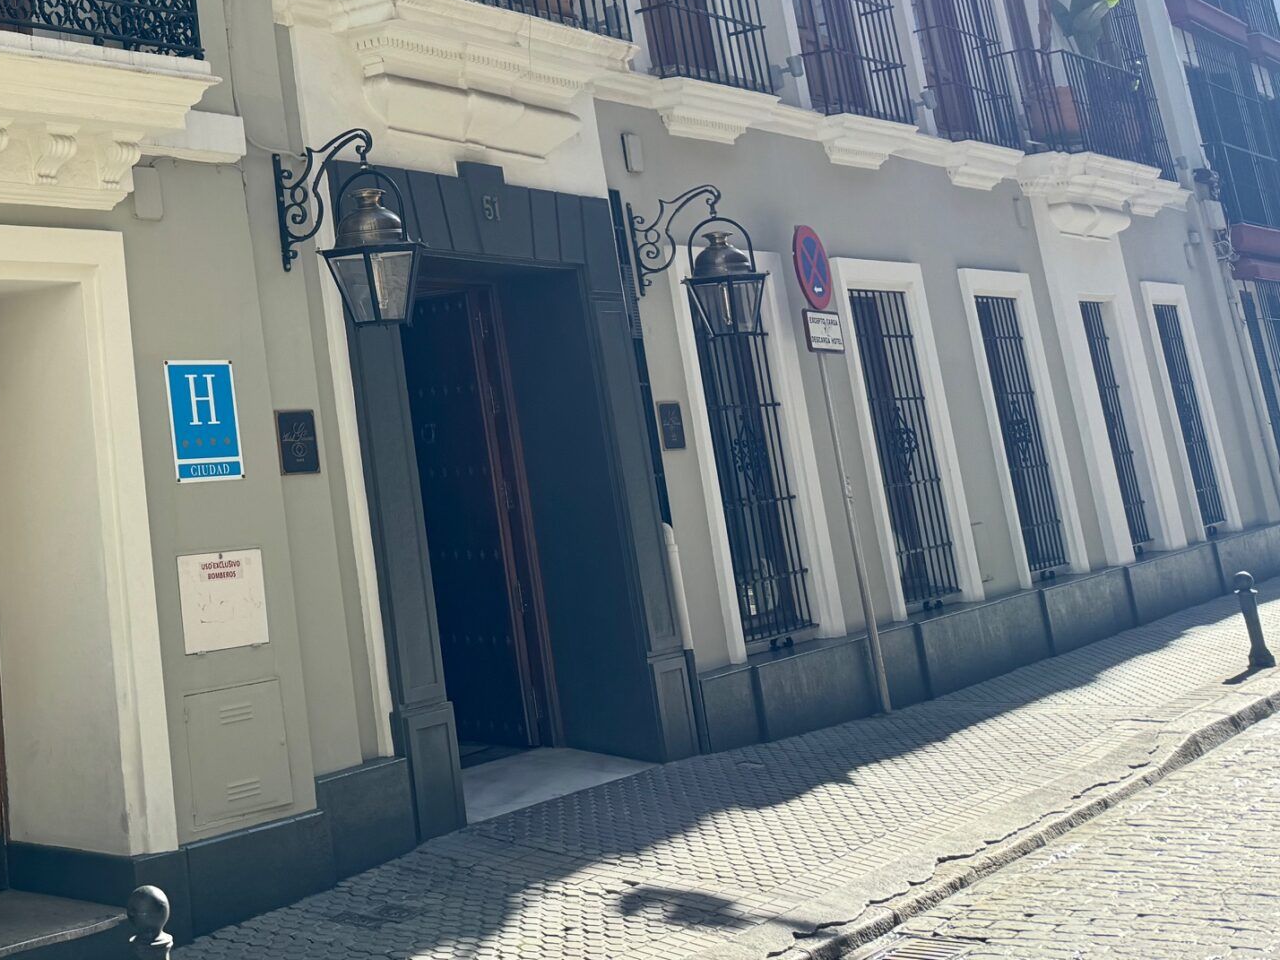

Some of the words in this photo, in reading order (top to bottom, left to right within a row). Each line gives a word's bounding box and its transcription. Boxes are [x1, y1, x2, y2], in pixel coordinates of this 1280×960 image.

[482, 195, 500, 221] 51
[184, 374, 221, 425] H
[190, 463, 230, 477] CIUDAD
[201, 562, 213, 570] USO
[213, 560, 241, 569] EXCLUSIVO
[207, 570, 237, 580] BOMBEROS
